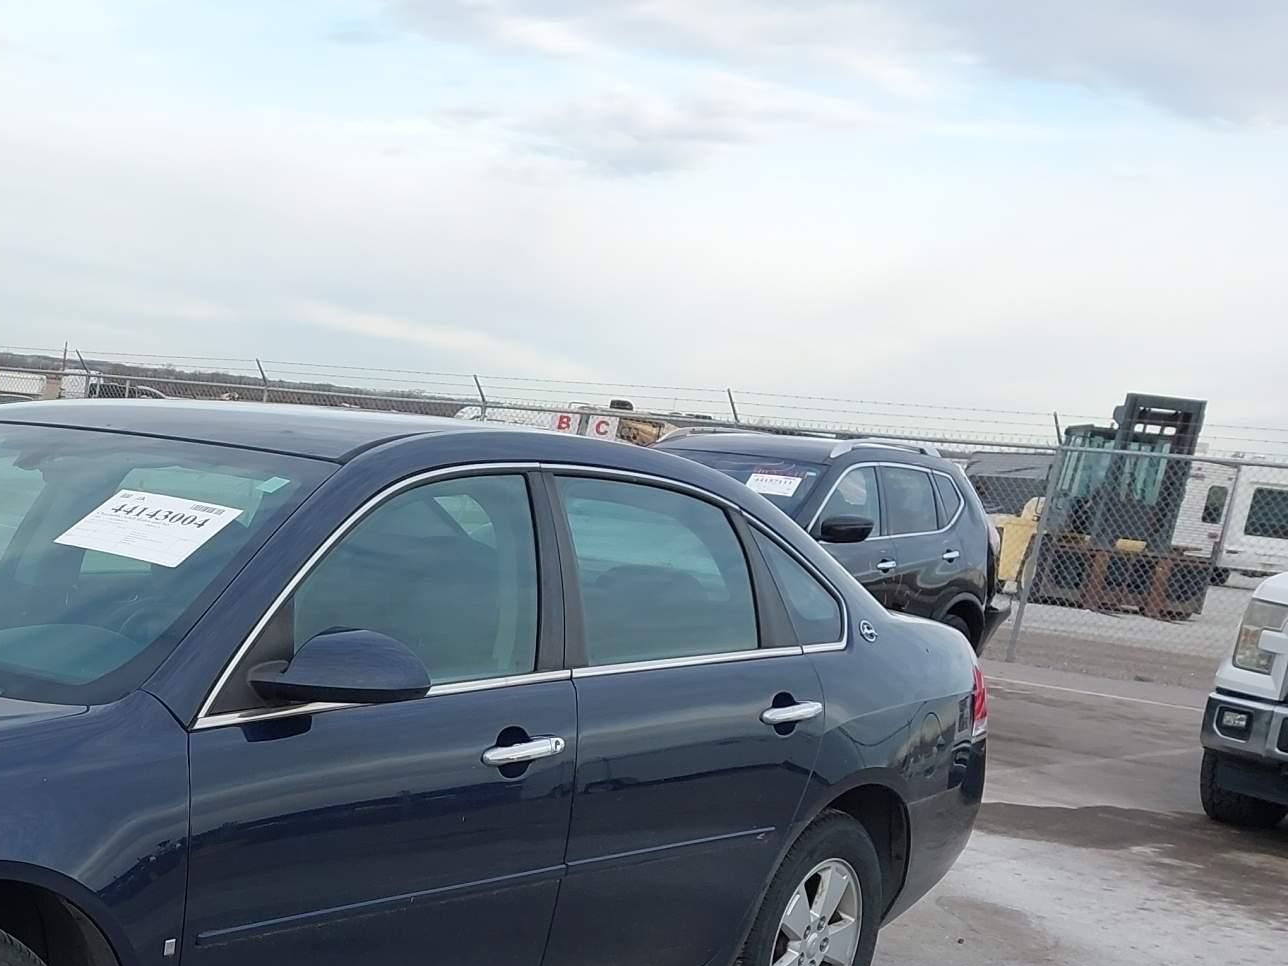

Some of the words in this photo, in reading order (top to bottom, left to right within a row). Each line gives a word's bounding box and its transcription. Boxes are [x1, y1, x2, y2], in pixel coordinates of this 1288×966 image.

[557, 415, 571, 430] B
[595, 420, 610, 435] C
[111, 503, 210, 529] 44143004
